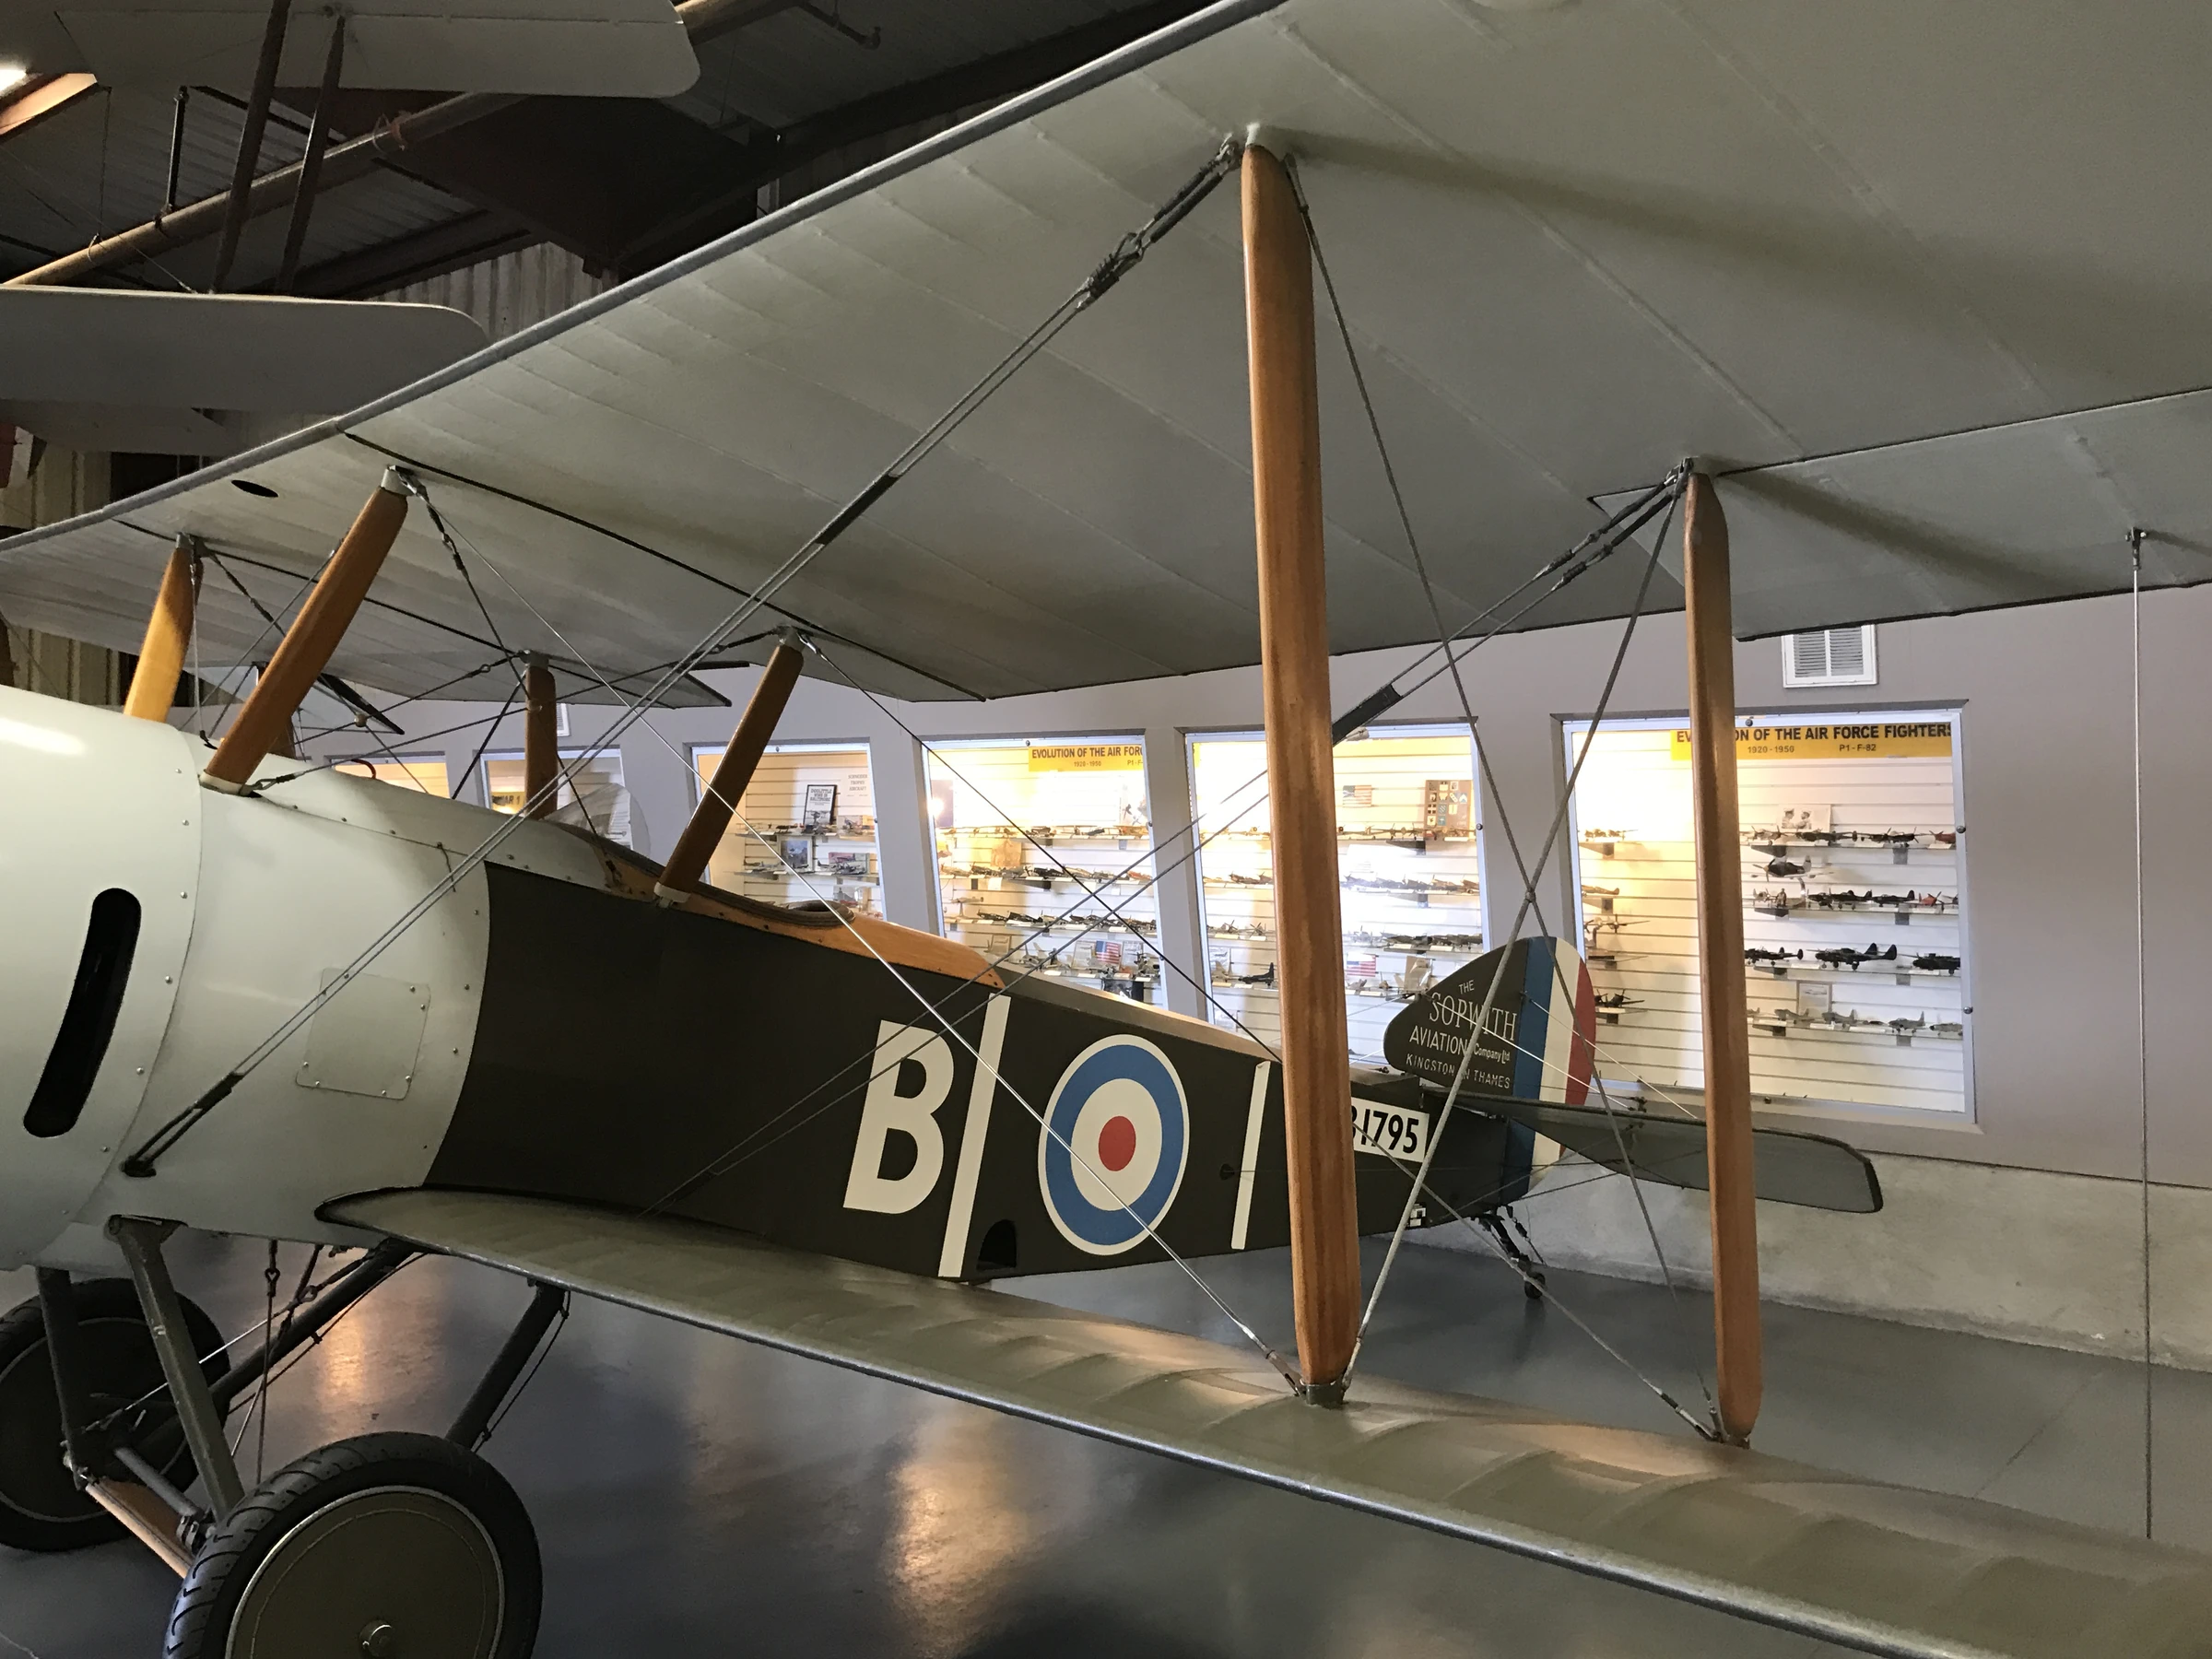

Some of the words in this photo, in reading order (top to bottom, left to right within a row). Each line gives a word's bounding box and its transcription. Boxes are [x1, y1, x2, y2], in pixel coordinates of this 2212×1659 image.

[1754, 729, 1771, 741] OF
[1774, 728, 1801, 740] THE
[1805, 727, 1829, 739] AIR
[1833, 726, 1879, 739] FORCE
[1032, 748, 1075, 759] EVOLUTION
[1077, 747, 1088, 758] OF
[1089, 747, 1105, 757] THE
[1107, 747, 1121, 757] AIR
[1458, 980, 1475, 994] THE
[1429, 992, 1517, 1041] SOPWITH
[1409, 1025, 1468, 1057] AVIATION
[1473, 1042, 1501, 1063] Company
[1406, 1053, 1455, 1077] KINGSTON
[1474, 1069, 1511, 1089] THAMES
[842, 1019, 955, 1215] B
